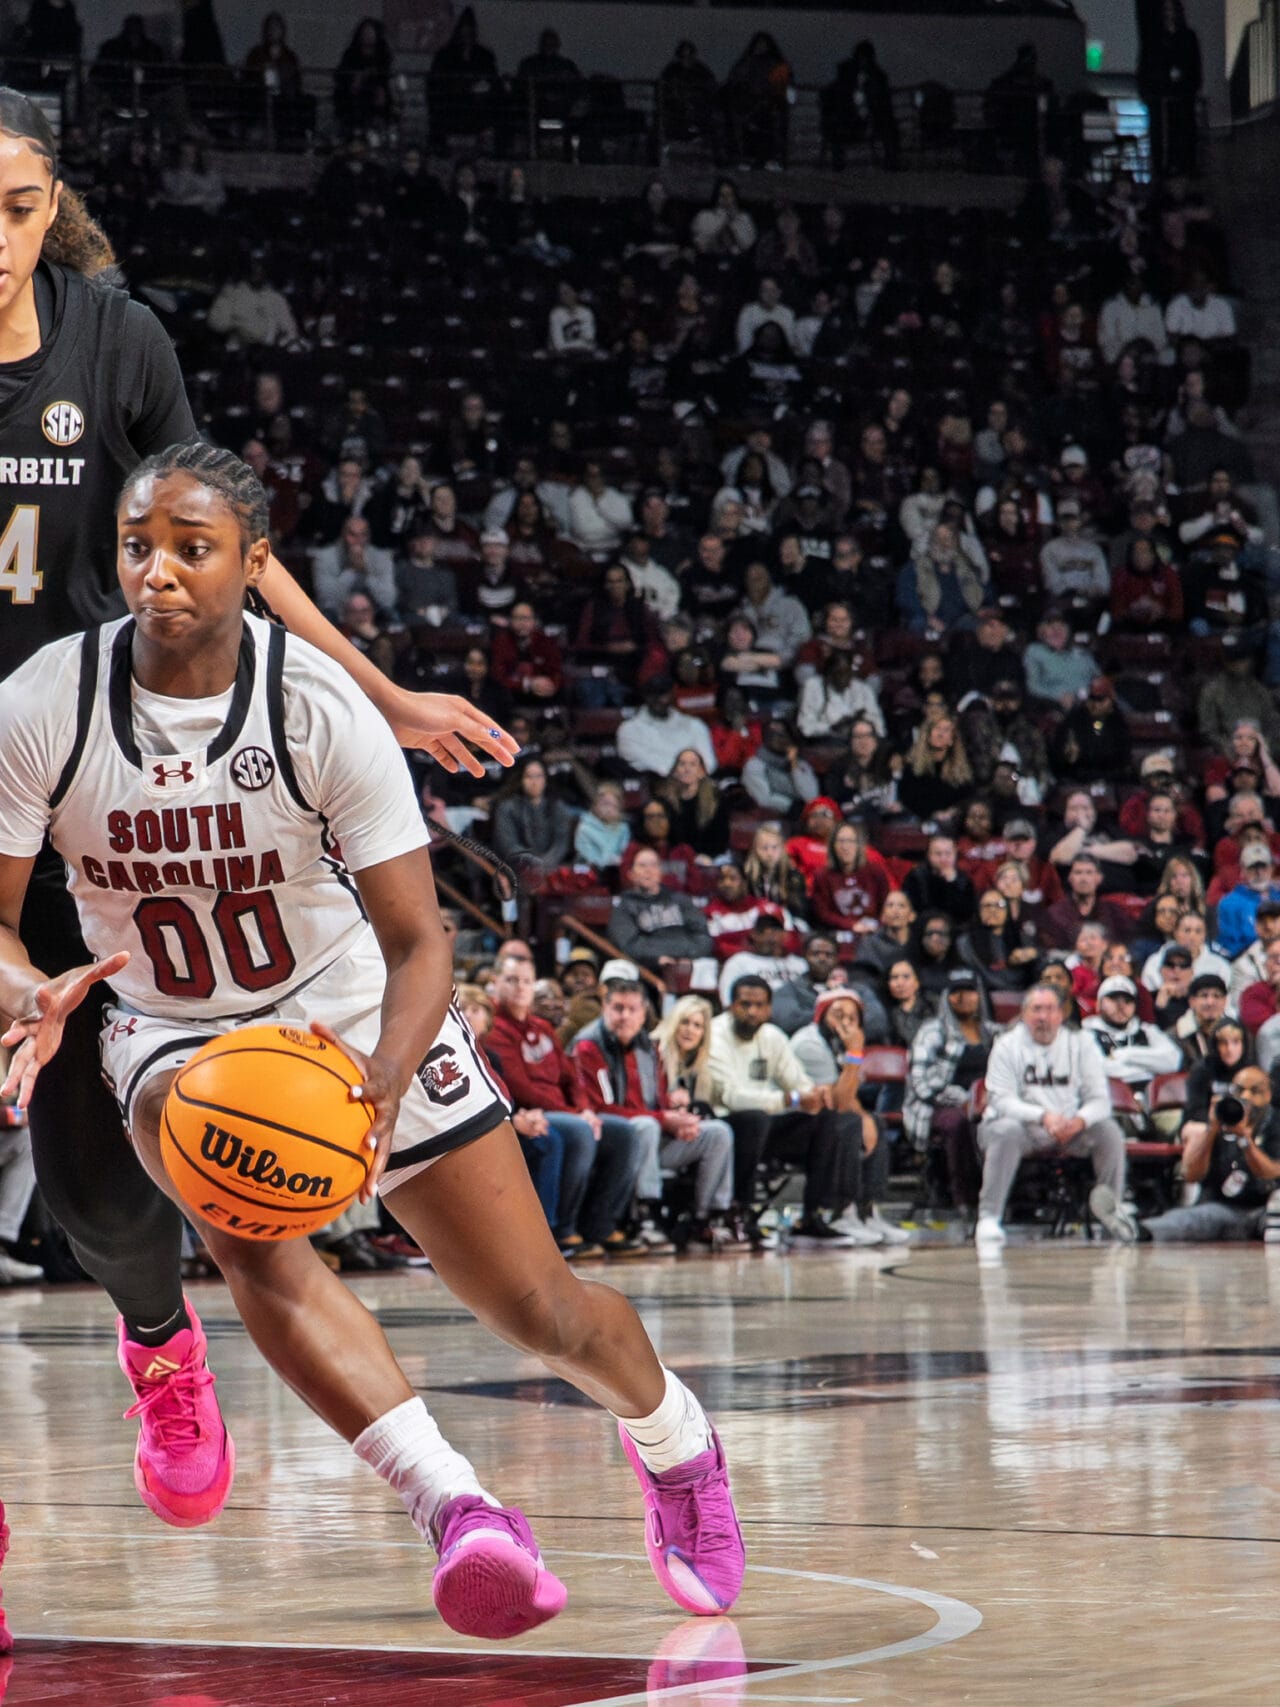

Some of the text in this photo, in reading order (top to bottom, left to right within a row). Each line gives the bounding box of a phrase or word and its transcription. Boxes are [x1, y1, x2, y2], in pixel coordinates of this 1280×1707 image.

[44, 403, 83, 443] SEC
[233, 750, 273, 789] SEC
[107, 802, 247, 854] SOUTH
[81, 848, 287, 895] CAROLINA
[132, 888, 297, 1000] 00
[199, 1121, 333, 1198] Wilson
